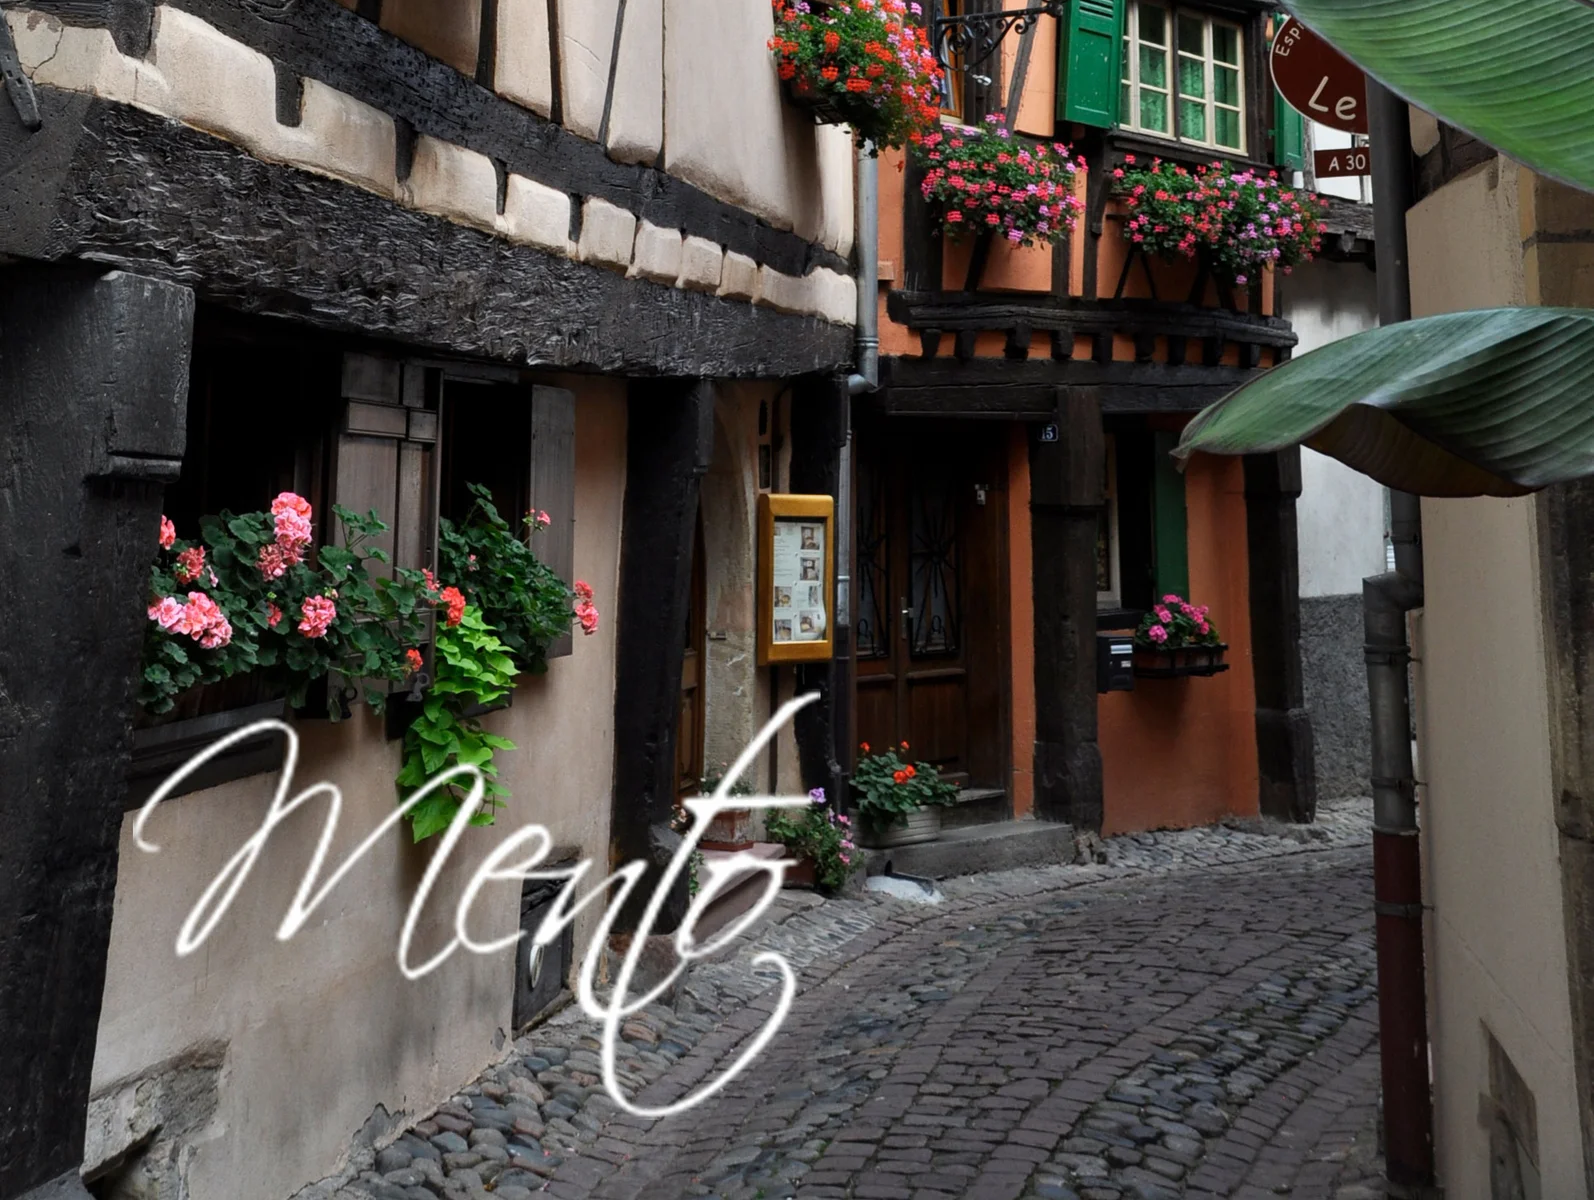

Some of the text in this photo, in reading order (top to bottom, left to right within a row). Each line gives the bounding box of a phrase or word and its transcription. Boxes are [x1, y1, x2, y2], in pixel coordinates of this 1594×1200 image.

[1308, 75, 1357, 120] Le
[1328, 153, 1366, 172] A 30
